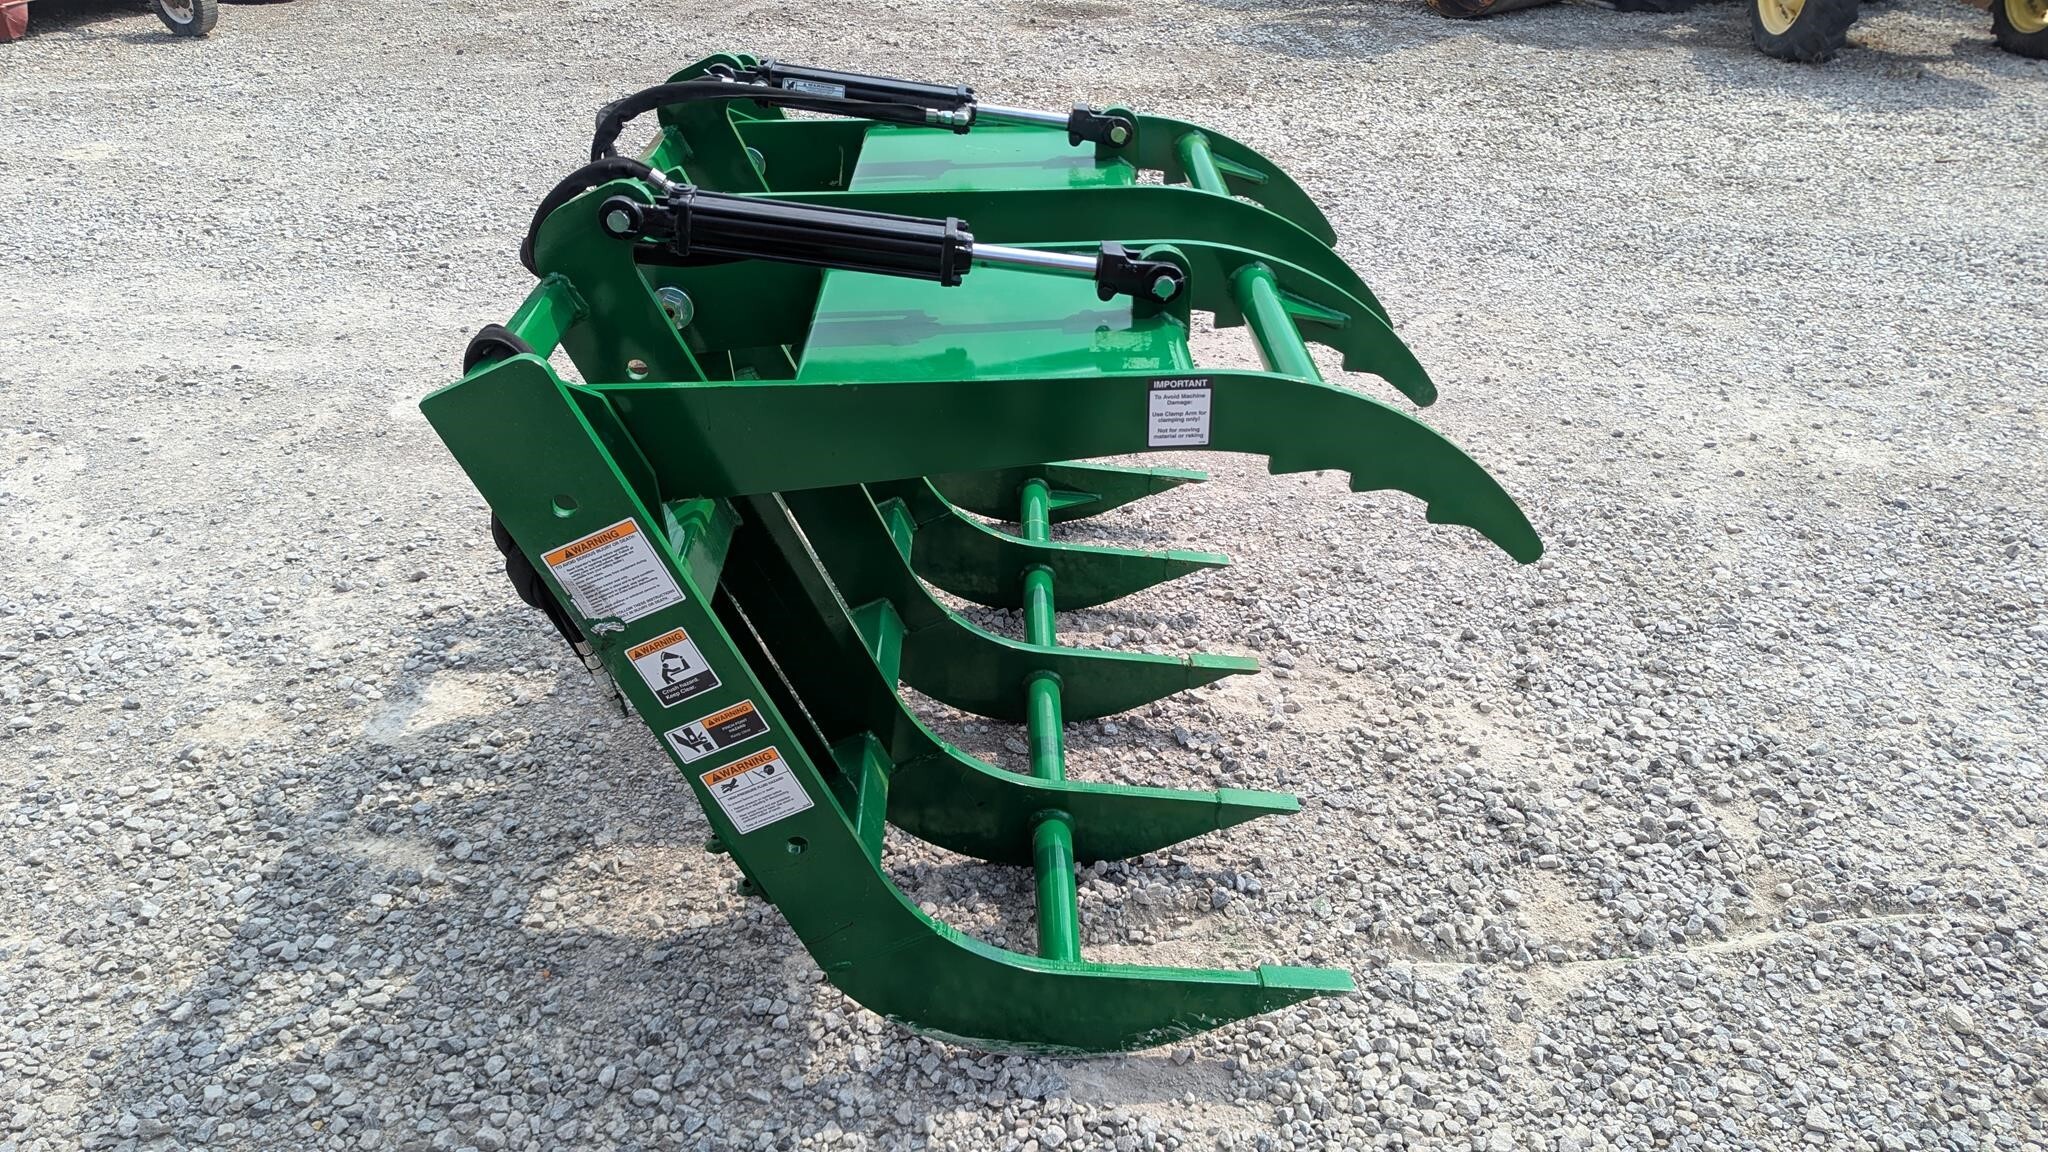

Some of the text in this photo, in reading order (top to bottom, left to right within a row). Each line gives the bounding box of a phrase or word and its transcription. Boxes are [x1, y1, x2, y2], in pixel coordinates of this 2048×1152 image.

[1153, 379, 1208, 389] IMPORTANT
[571, 529, 620, 555] WARNING
[562, 559, 577, 568] AVOID
[576, 551, 596, 562] SERIOUS
[595, 544, 613, 554] INJURY
[640, 633, 683, 654] WARNING
[661, 685, 680, 695] Crush
[665, 691, 681, 700] Keep
[713, 705, 748, 722] WARNING
[718, 752, 772, 778] WARNING
